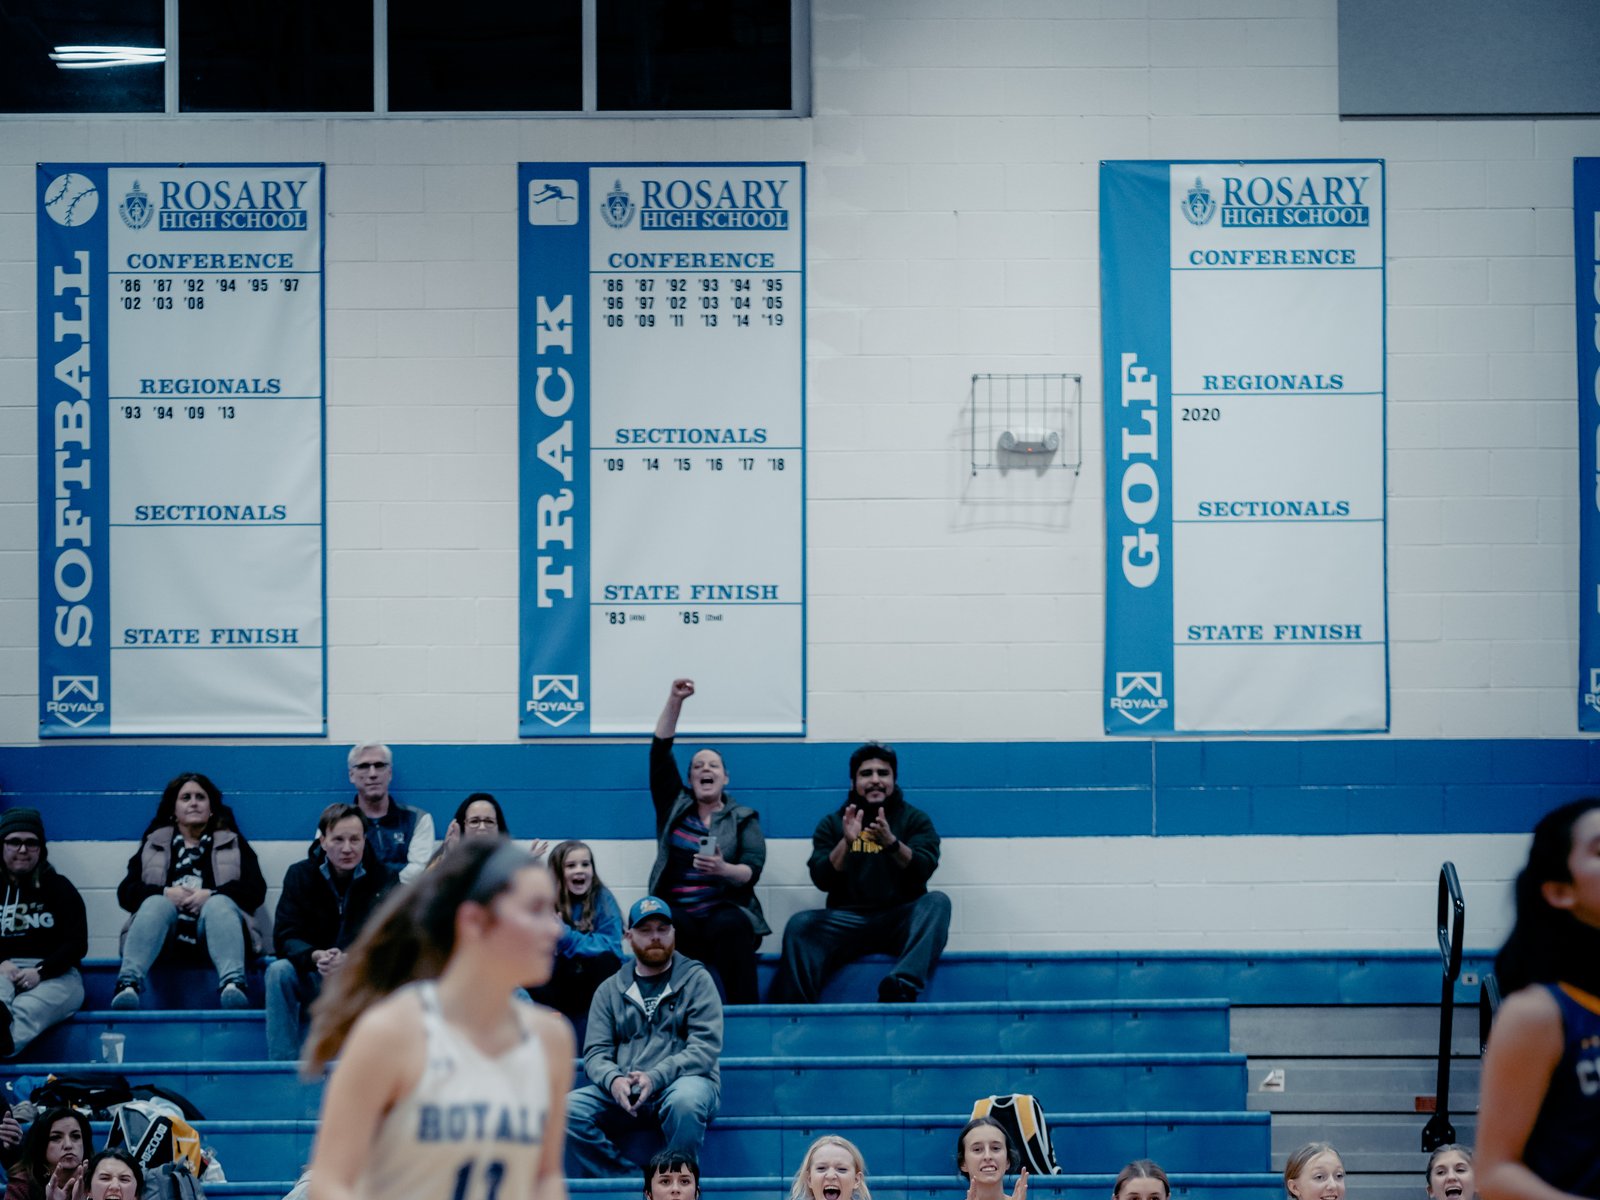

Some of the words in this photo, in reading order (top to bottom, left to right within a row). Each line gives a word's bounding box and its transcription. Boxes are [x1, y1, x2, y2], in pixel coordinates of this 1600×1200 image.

[160, 181, 307, 210] ROSARY
[641, 180, 788, 209] ROSARY
[1222, 177, 1369, 206] ROSARY
[161, 212, 219, 230] HIGH
[221, 211, 306, 230] SCHOOL
[643, 211, 697, 229] HIGH
[701, 211, 788, 229] SCHOOL
[1224, 208, 1278, 225] HIGH
[1283, 208, 1368, 225] SCHOOL
[127, 253, 293, 269] CONFERENCE
[608, 253, 774, 268] CONFERENCE
[1190, 249, 1356, 265] CONFERENCE
[121, 279, 140, 292] '86
[154, 279, 172, 292] '87
[184, 279, 204, 292] '92
[216, 279, 235, 292] '94
[248, 279, 268, 291] '95
[280, 279, 299, 291] '97
[603, 279, 623, 292] '86
[635, 279, 654, 292] '87
[666, 279, 686, 291] '92
[699, 279, 718, 291] '93
[731, 279, 750, 291] '94
[763, 279, 782, 291] '95
[121, 297, 140, 310] '02
[153, 297, 173, 309] '03
[184, 297, 204, 309] '08
[603, 297, 623, 309] '96
[636, 297, 654, 309] '97
[666, 297, 686, 309] '02
[699, 297, 718, 309] '03
[731, 297, 750, 309] '04
[763, 297, 782, 309] '05
[603, 315, 623, 327] '06
[635, 315, 655, 327] '09
[670, 314, 683, 327] '11
[701, 314, 717, 327] '13
[733, 315, 749, 326] '14
[762, 314, 783, 326] '19
[140, 379, 280, 394] REGIONALS
[1203, 374, 1344, 390] REGIONALS
[121, 406, 141, 419] '93
[154, 407, 173, 419] '94
[185, 406, 204, 419] '09
[218, 406, 235, 419] '13
[1182, 408, 1220, 421] 2020
[616, 428, 766, 444] SECTIONALS
[54, 251, 93, 647] SOFTBALL
[536, 295, 574, 608] TRACK
[604, 458, 623, 471] '09
[643, 458, 659, 470] '14
[674, 458, 690, 471] '15
[706, 458, 722, 471] '16
[739, 458, 754, 470] '17
[768, 458, 784, 470] '18
[1121, 353, 1160, 588] GOLF
[135, 505, 286, 521] SECTIONALS
[1199, 501, 1349, 516] SECTIONALS
[604, 585, 679, 600] STATE
[691, 585, 778, 600] FINISH
[606, 612, 625, 624] '83
[680, 612, 699, 624] '85
[124, 629, 199, 644] STATE
[210, 629, 298, 644] FINISH
[1188, 625, 1263, 640] STATE
[1274, 624, 1361, 640] FINISH
[47, 701, 104, 713] ROYALS
[526, 700, 585, 713] ROYALS
[1110, 697, 1168, 709] ROYALS
